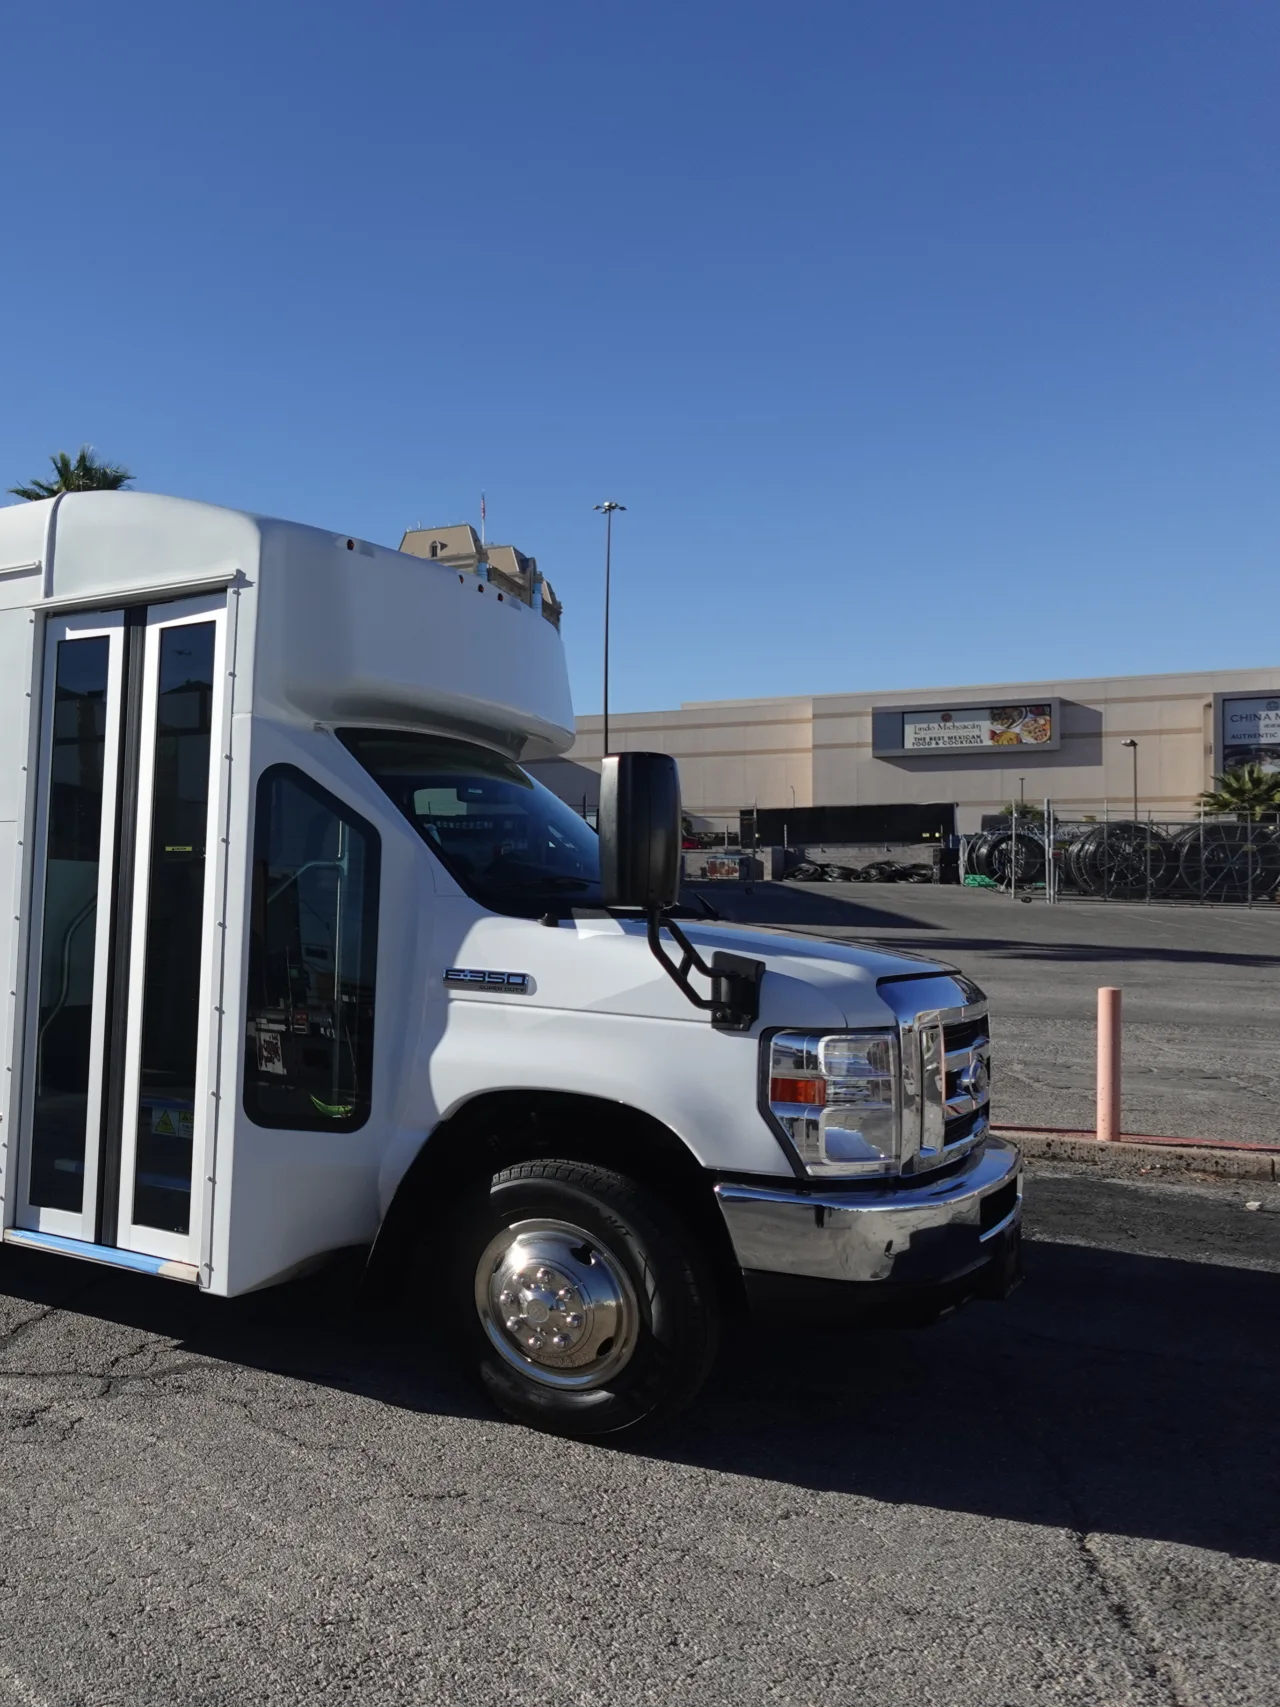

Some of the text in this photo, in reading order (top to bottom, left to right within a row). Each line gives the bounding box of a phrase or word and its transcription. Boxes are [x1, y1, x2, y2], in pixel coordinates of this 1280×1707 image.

[1230, 713, 1271, 722] CHINA
[914, 724, 935, 735] Lindo
[1231, 732, 1278, 740] AUTHENTIC
